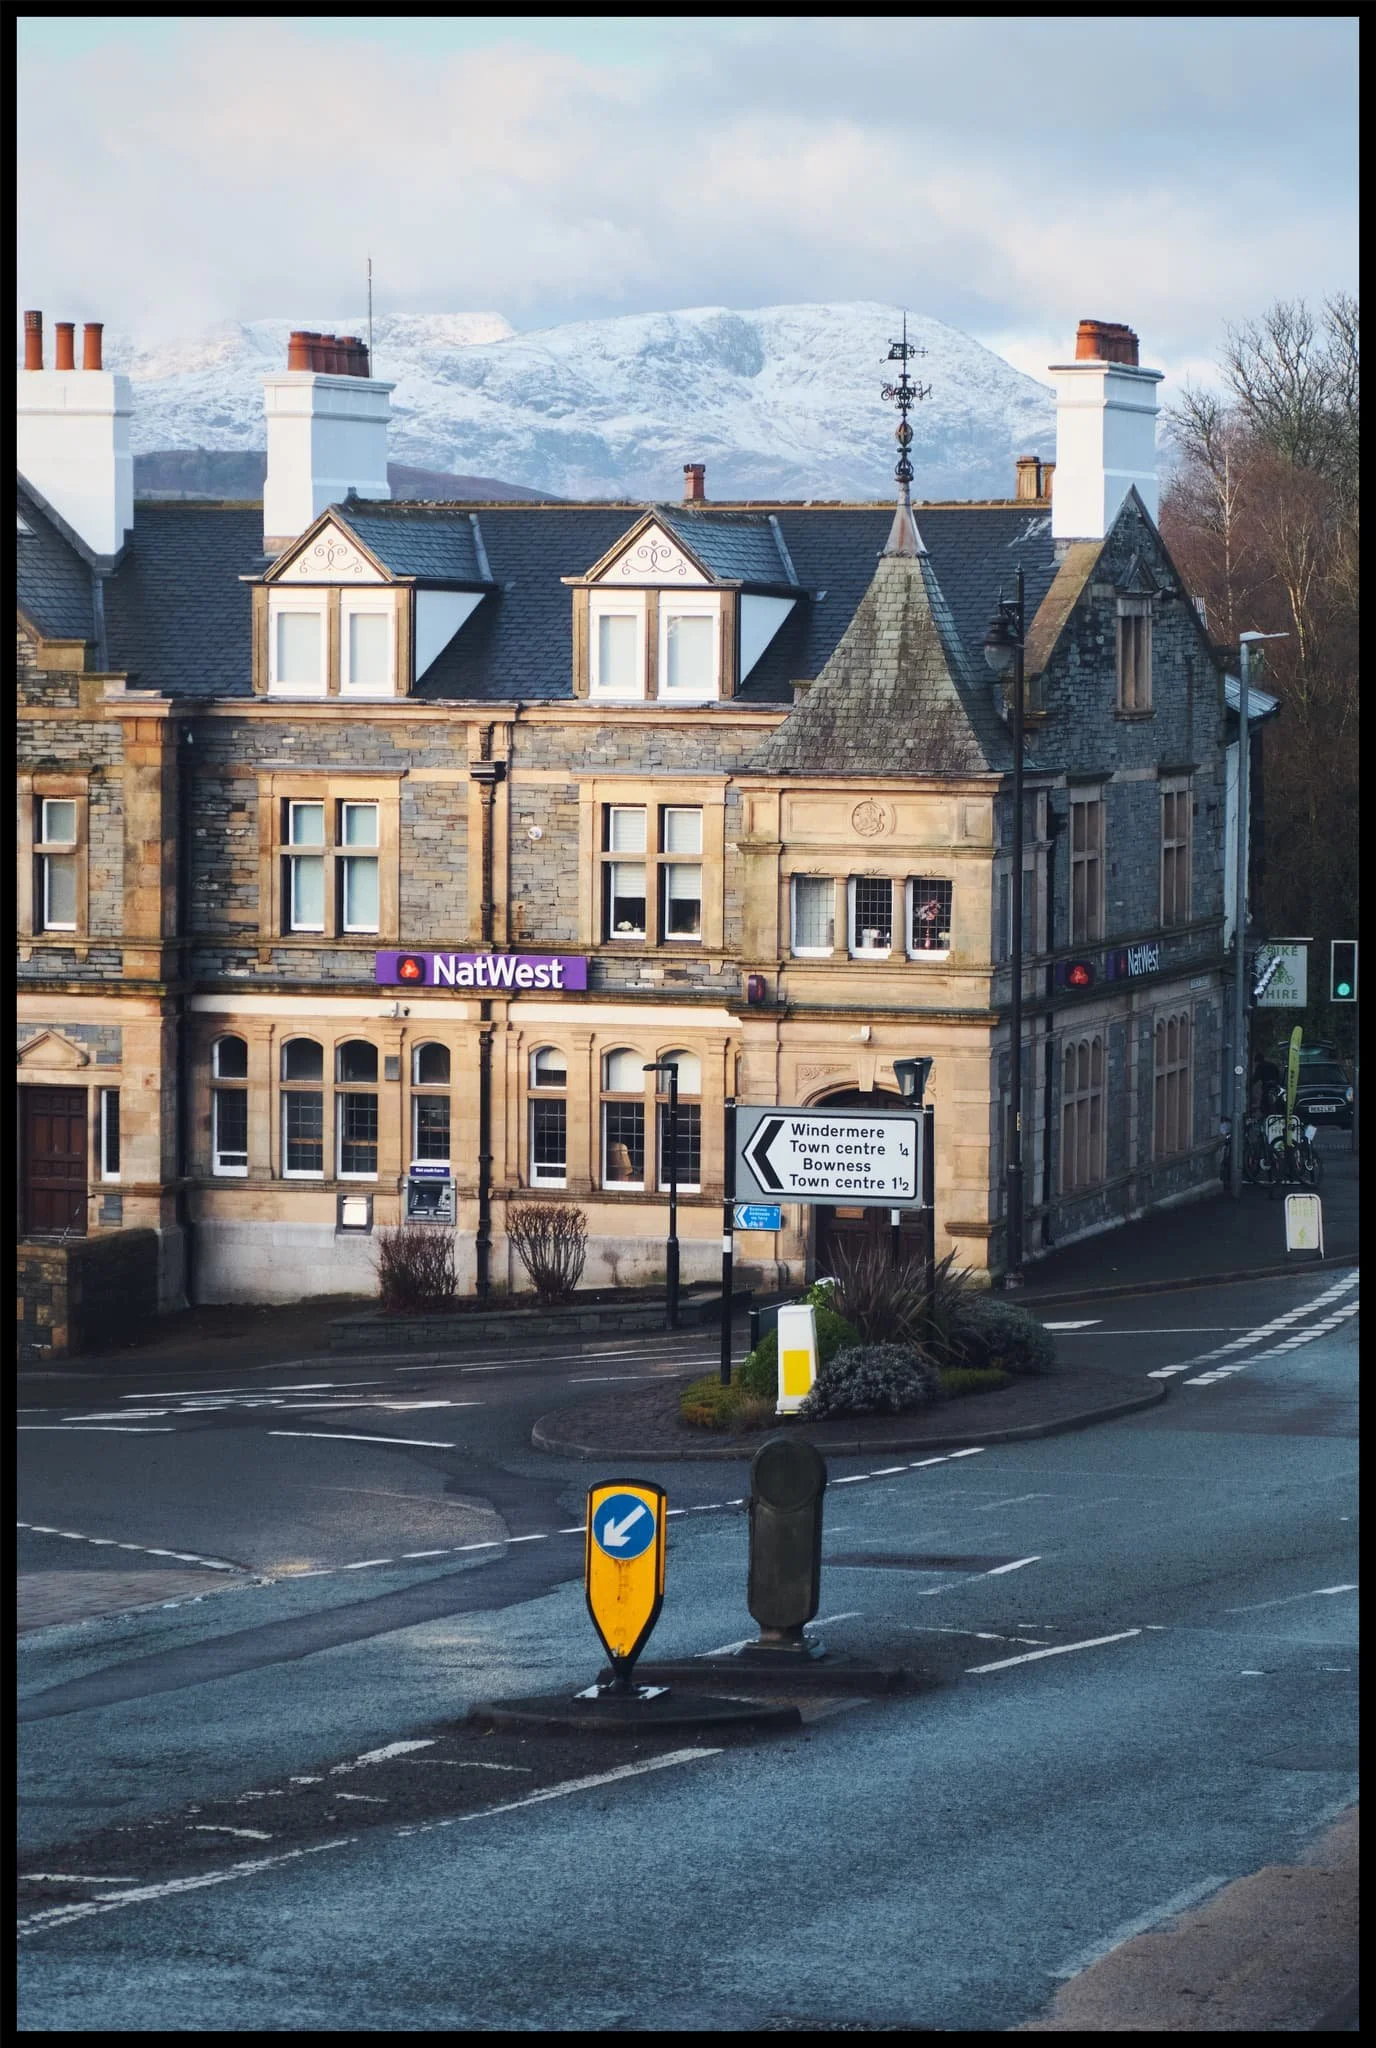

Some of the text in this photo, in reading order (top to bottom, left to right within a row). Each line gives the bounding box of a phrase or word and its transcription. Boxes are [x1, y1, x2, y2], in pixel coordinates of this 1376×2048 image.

[1128, 944, 1159, 976] NatWest
[433, 954, 563, 988] NatWest
[1266, 989, 1298, 999] HIRE
[791, 1123, 885, 1138] Windermere
[789, 1140, 829, 1154] Town
[835, 1142, 886, 1155] centre
[803, 1158, 871, 1172] Bowness
[789, 1174, 829, 1188] Town
[835, 1176, 885, 1190] centre
